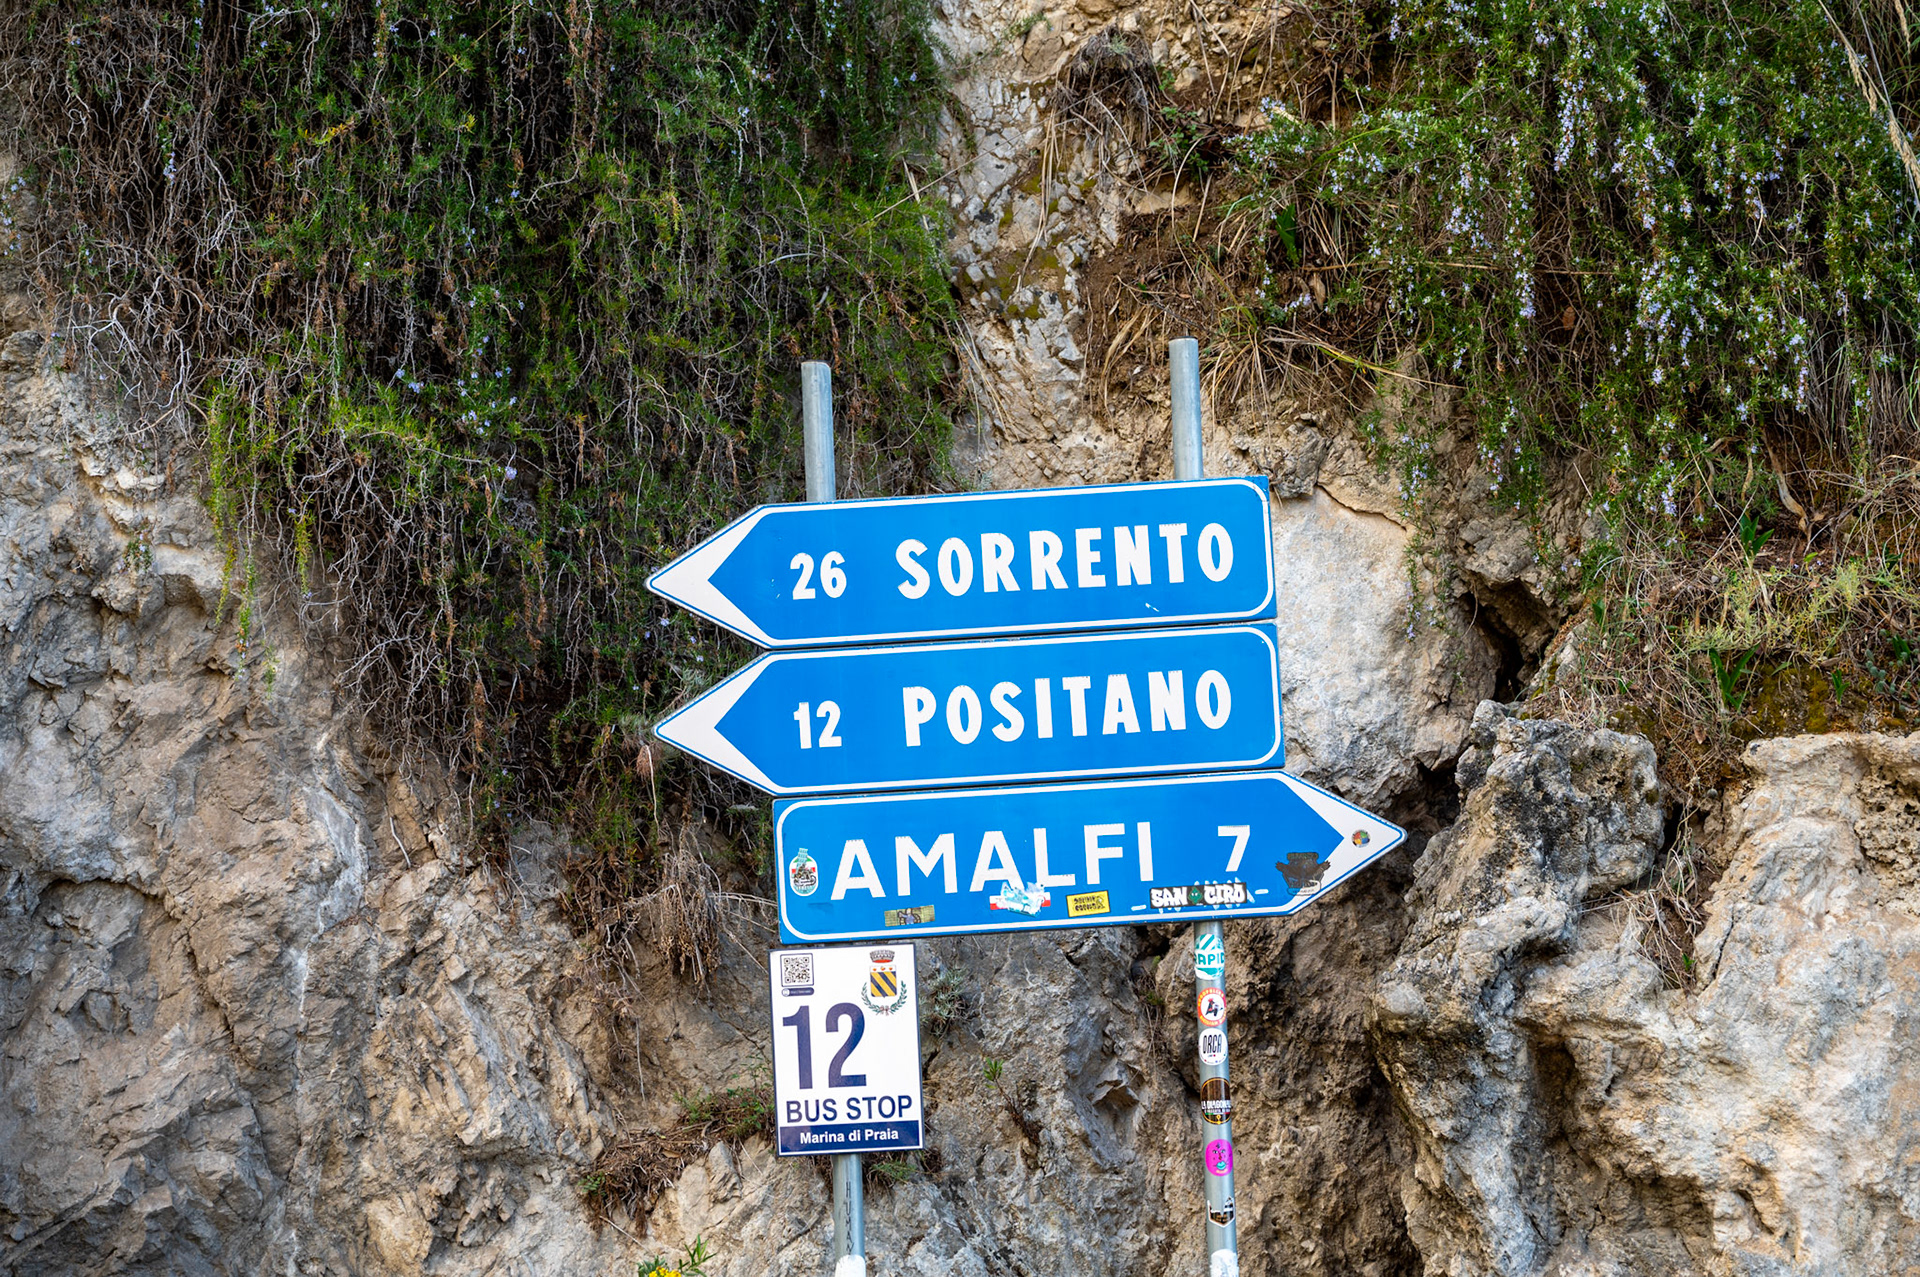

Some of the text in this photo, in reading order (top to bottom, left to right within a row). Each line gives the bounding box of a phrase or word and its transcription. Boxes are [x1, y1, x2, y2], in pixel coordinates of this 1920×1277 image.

[790, 522, 1234, 600] 26 SORRENTO
[793, 669, 1232, 750] 12 POSITANO
[830, 821, 1251, 901] AMALFI 7
[1151, 883, 1245, 907] SAN CIRO
[782, 1002, 867, 1090] 12
[786, 1094, 913, 1124] BUS STOP
[800, 1127, 899, 1145] Marina di Praia
